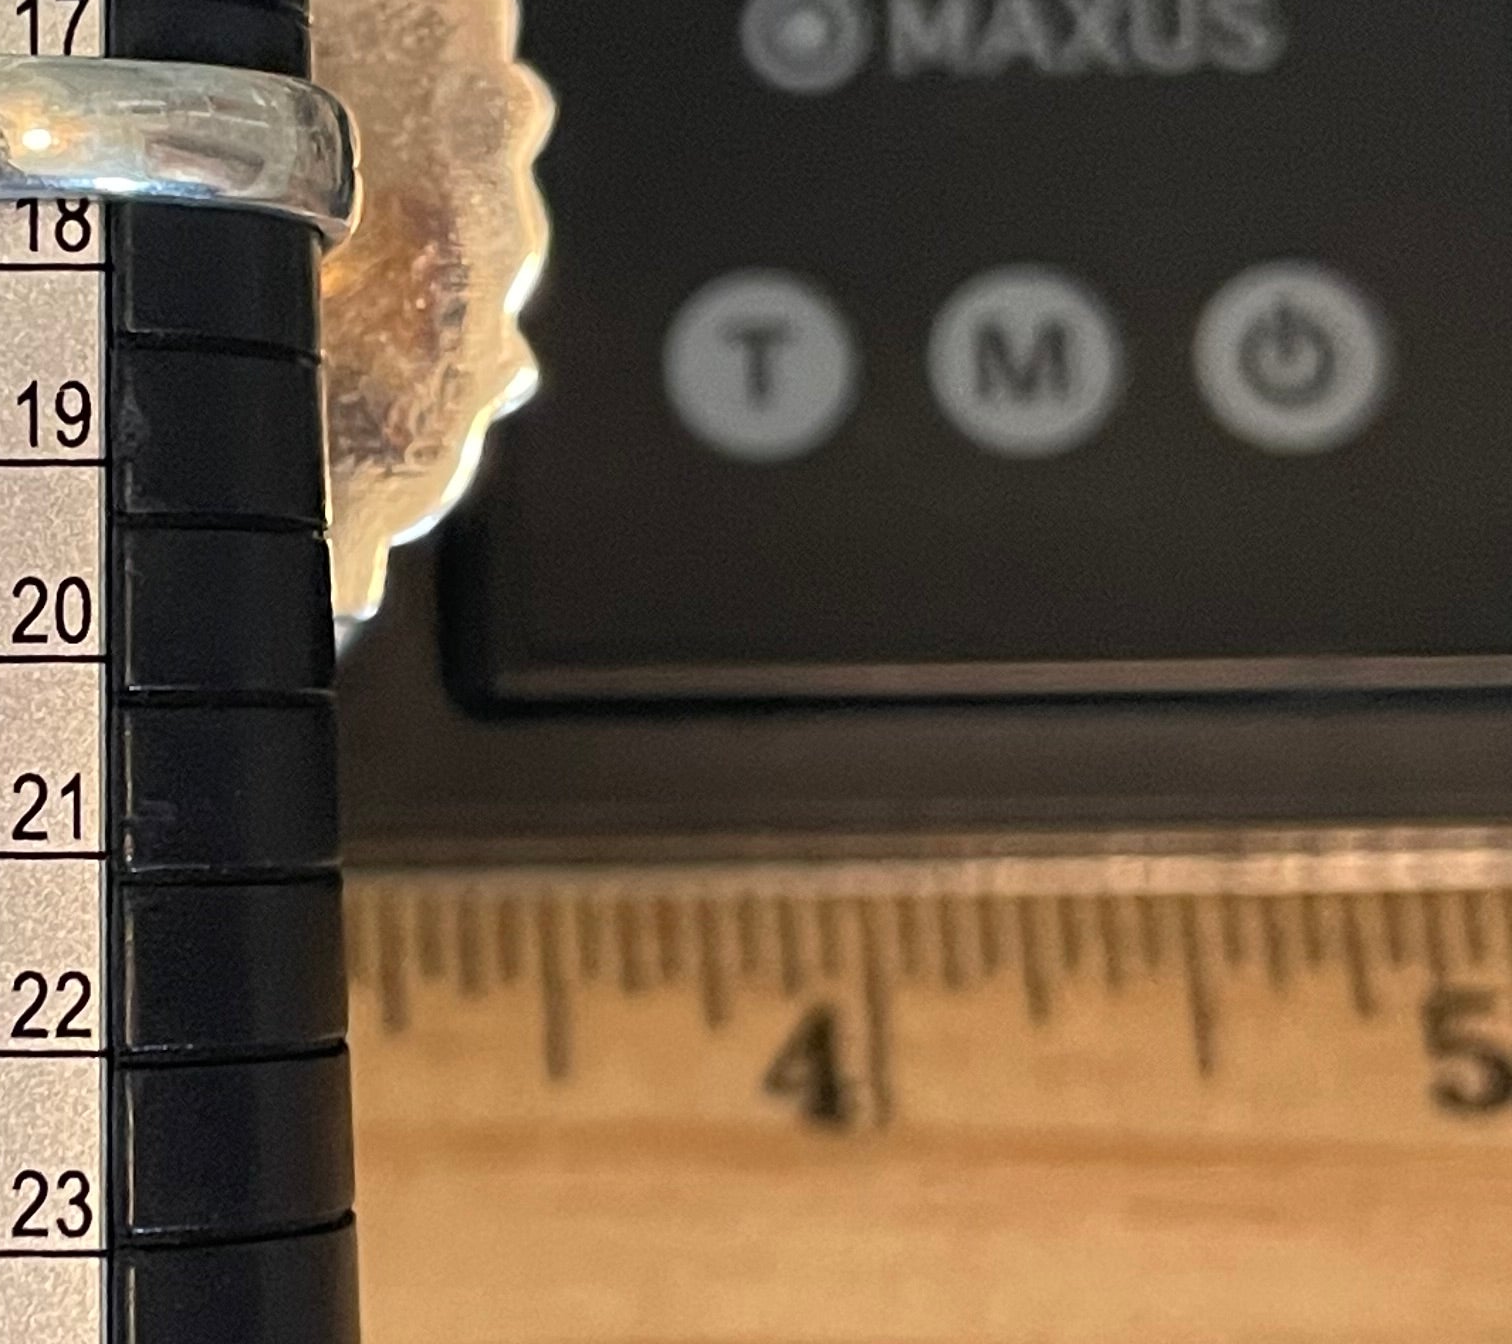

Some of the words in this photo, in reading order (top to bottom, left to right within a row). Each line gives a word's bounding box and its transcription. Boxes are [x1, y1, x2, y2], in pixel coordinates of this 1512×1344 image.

[16, 195, 93, 254] 18
[722, 313, 799, 412] T
[971, 317, 1072, 404] M
[16, 378, 93, 450] 19
[10, 574, 93, 646] 20
[10, 771, 83, 843] 21
[10, 969, 93, 1040] 22
[763, 1005, 859, 1133] 4
[1421, 986, 1512, 1116] 5
[10, 1168, 93, 1240] 23
